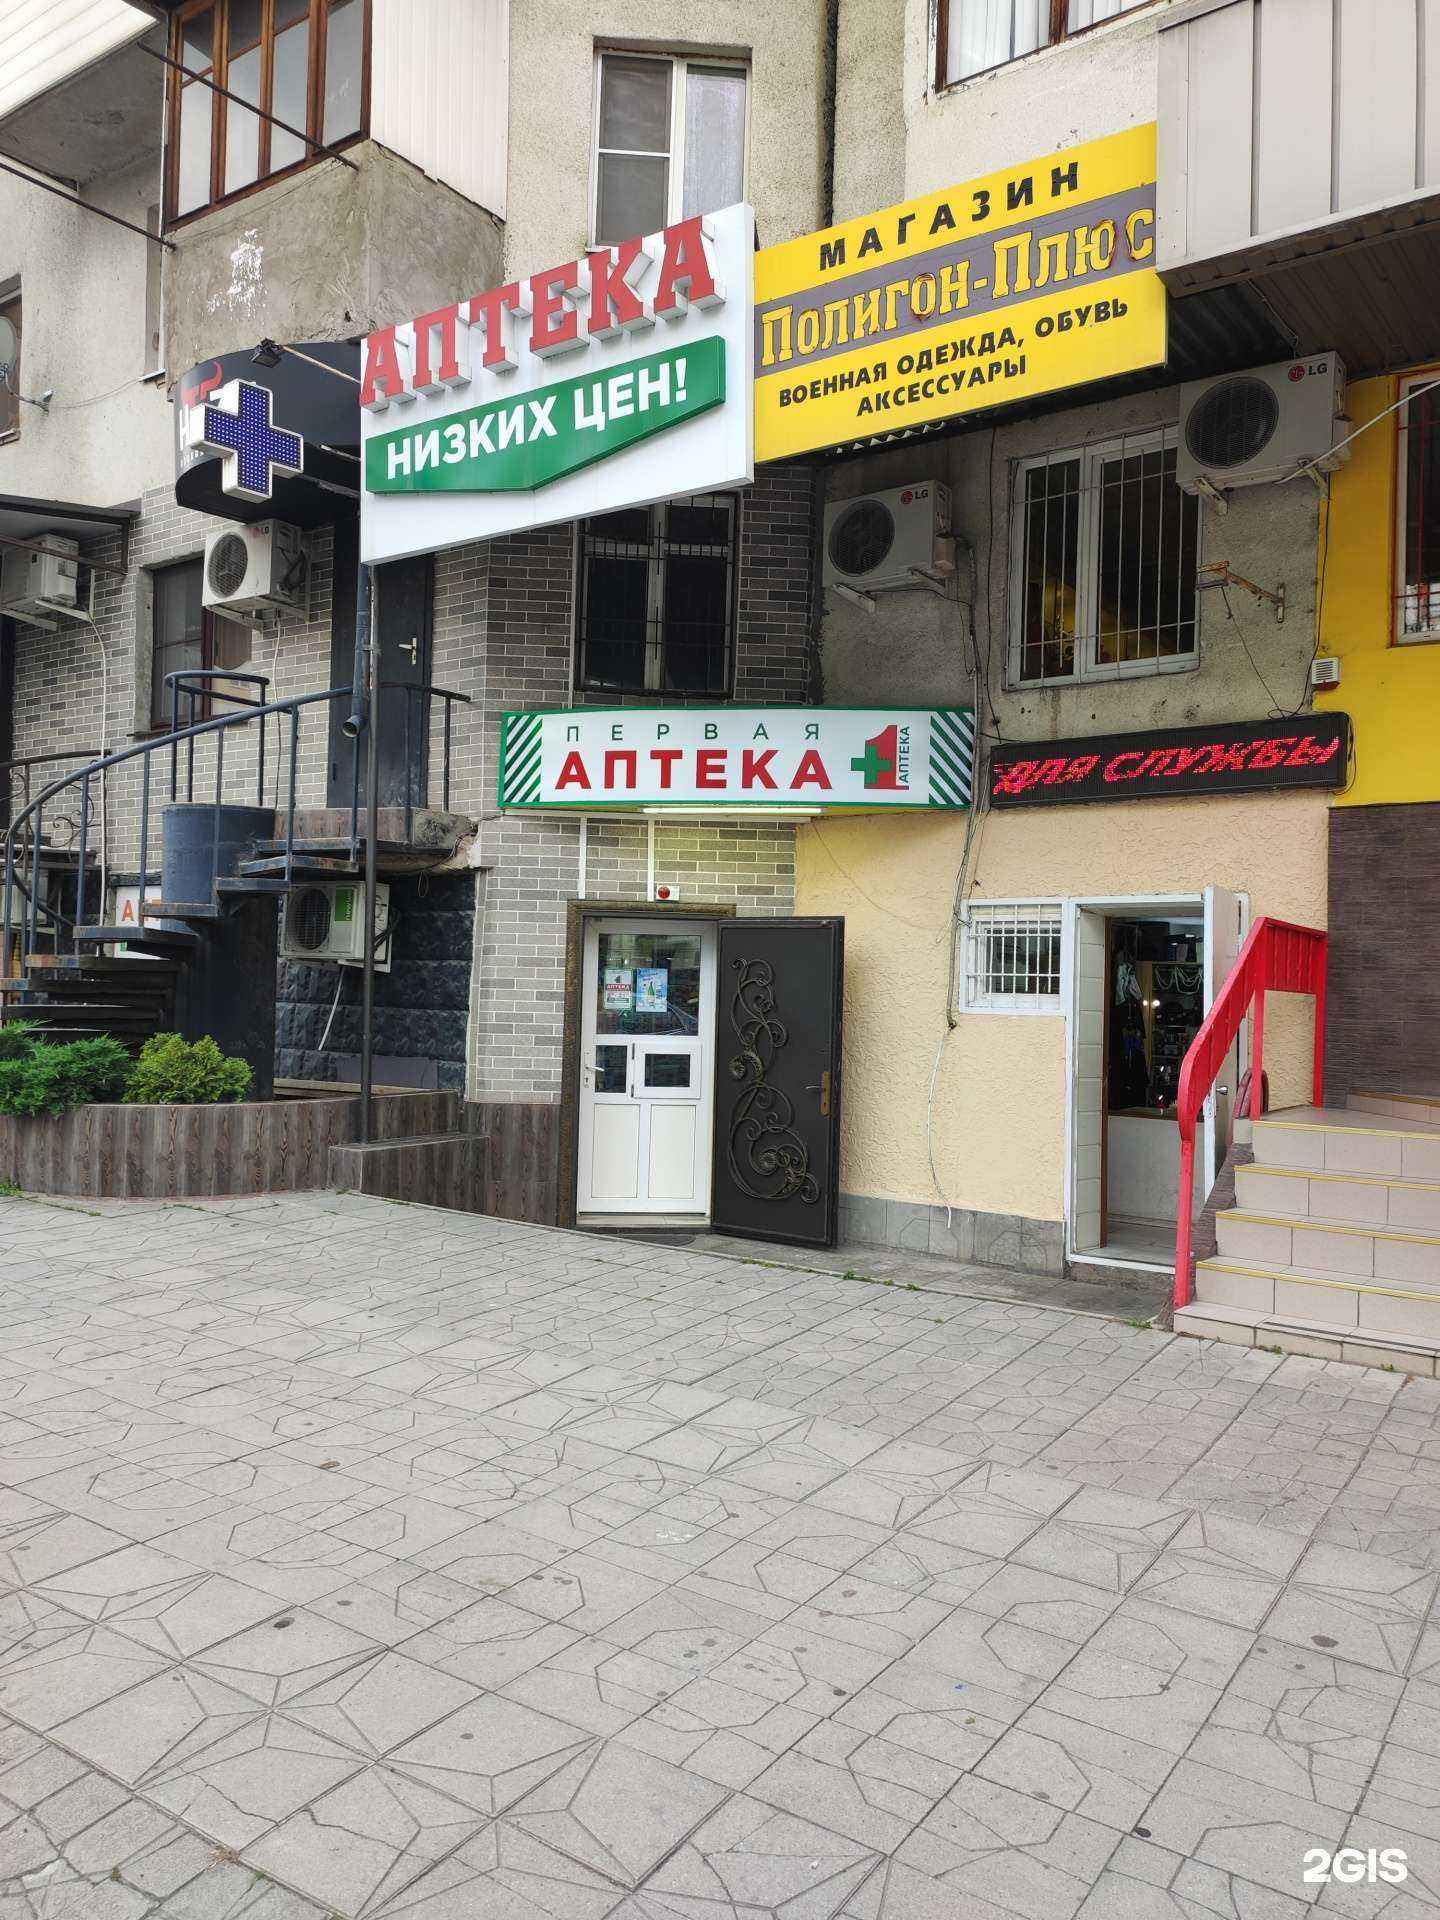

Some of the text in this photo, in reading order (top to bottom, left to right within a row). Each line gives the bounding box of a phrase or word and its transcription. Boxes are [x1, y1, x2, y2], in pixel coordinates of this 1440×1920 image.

[819, 161, 1079, 271] МАГАЗИН
[360, 215, 716, 410] АПТЕКА
[779, 298, 1129, 407] ВОЕННАЯ ОДЕЖДА, ОБУВЬ
[1308, 363, 1328, 376] LG
[856, 355, 1027, 416] АКСЕССУАРЫ
[387, 357, 688, 480] НИЗКИХ ЦЕН!
[915, 489, 929, 499] LG
[566, 723, 820, 742] ПЕРВАЯ
[898, 726, 910, 784] АПТЕКА
[555, 749, 833, 790] АПТЕКА
